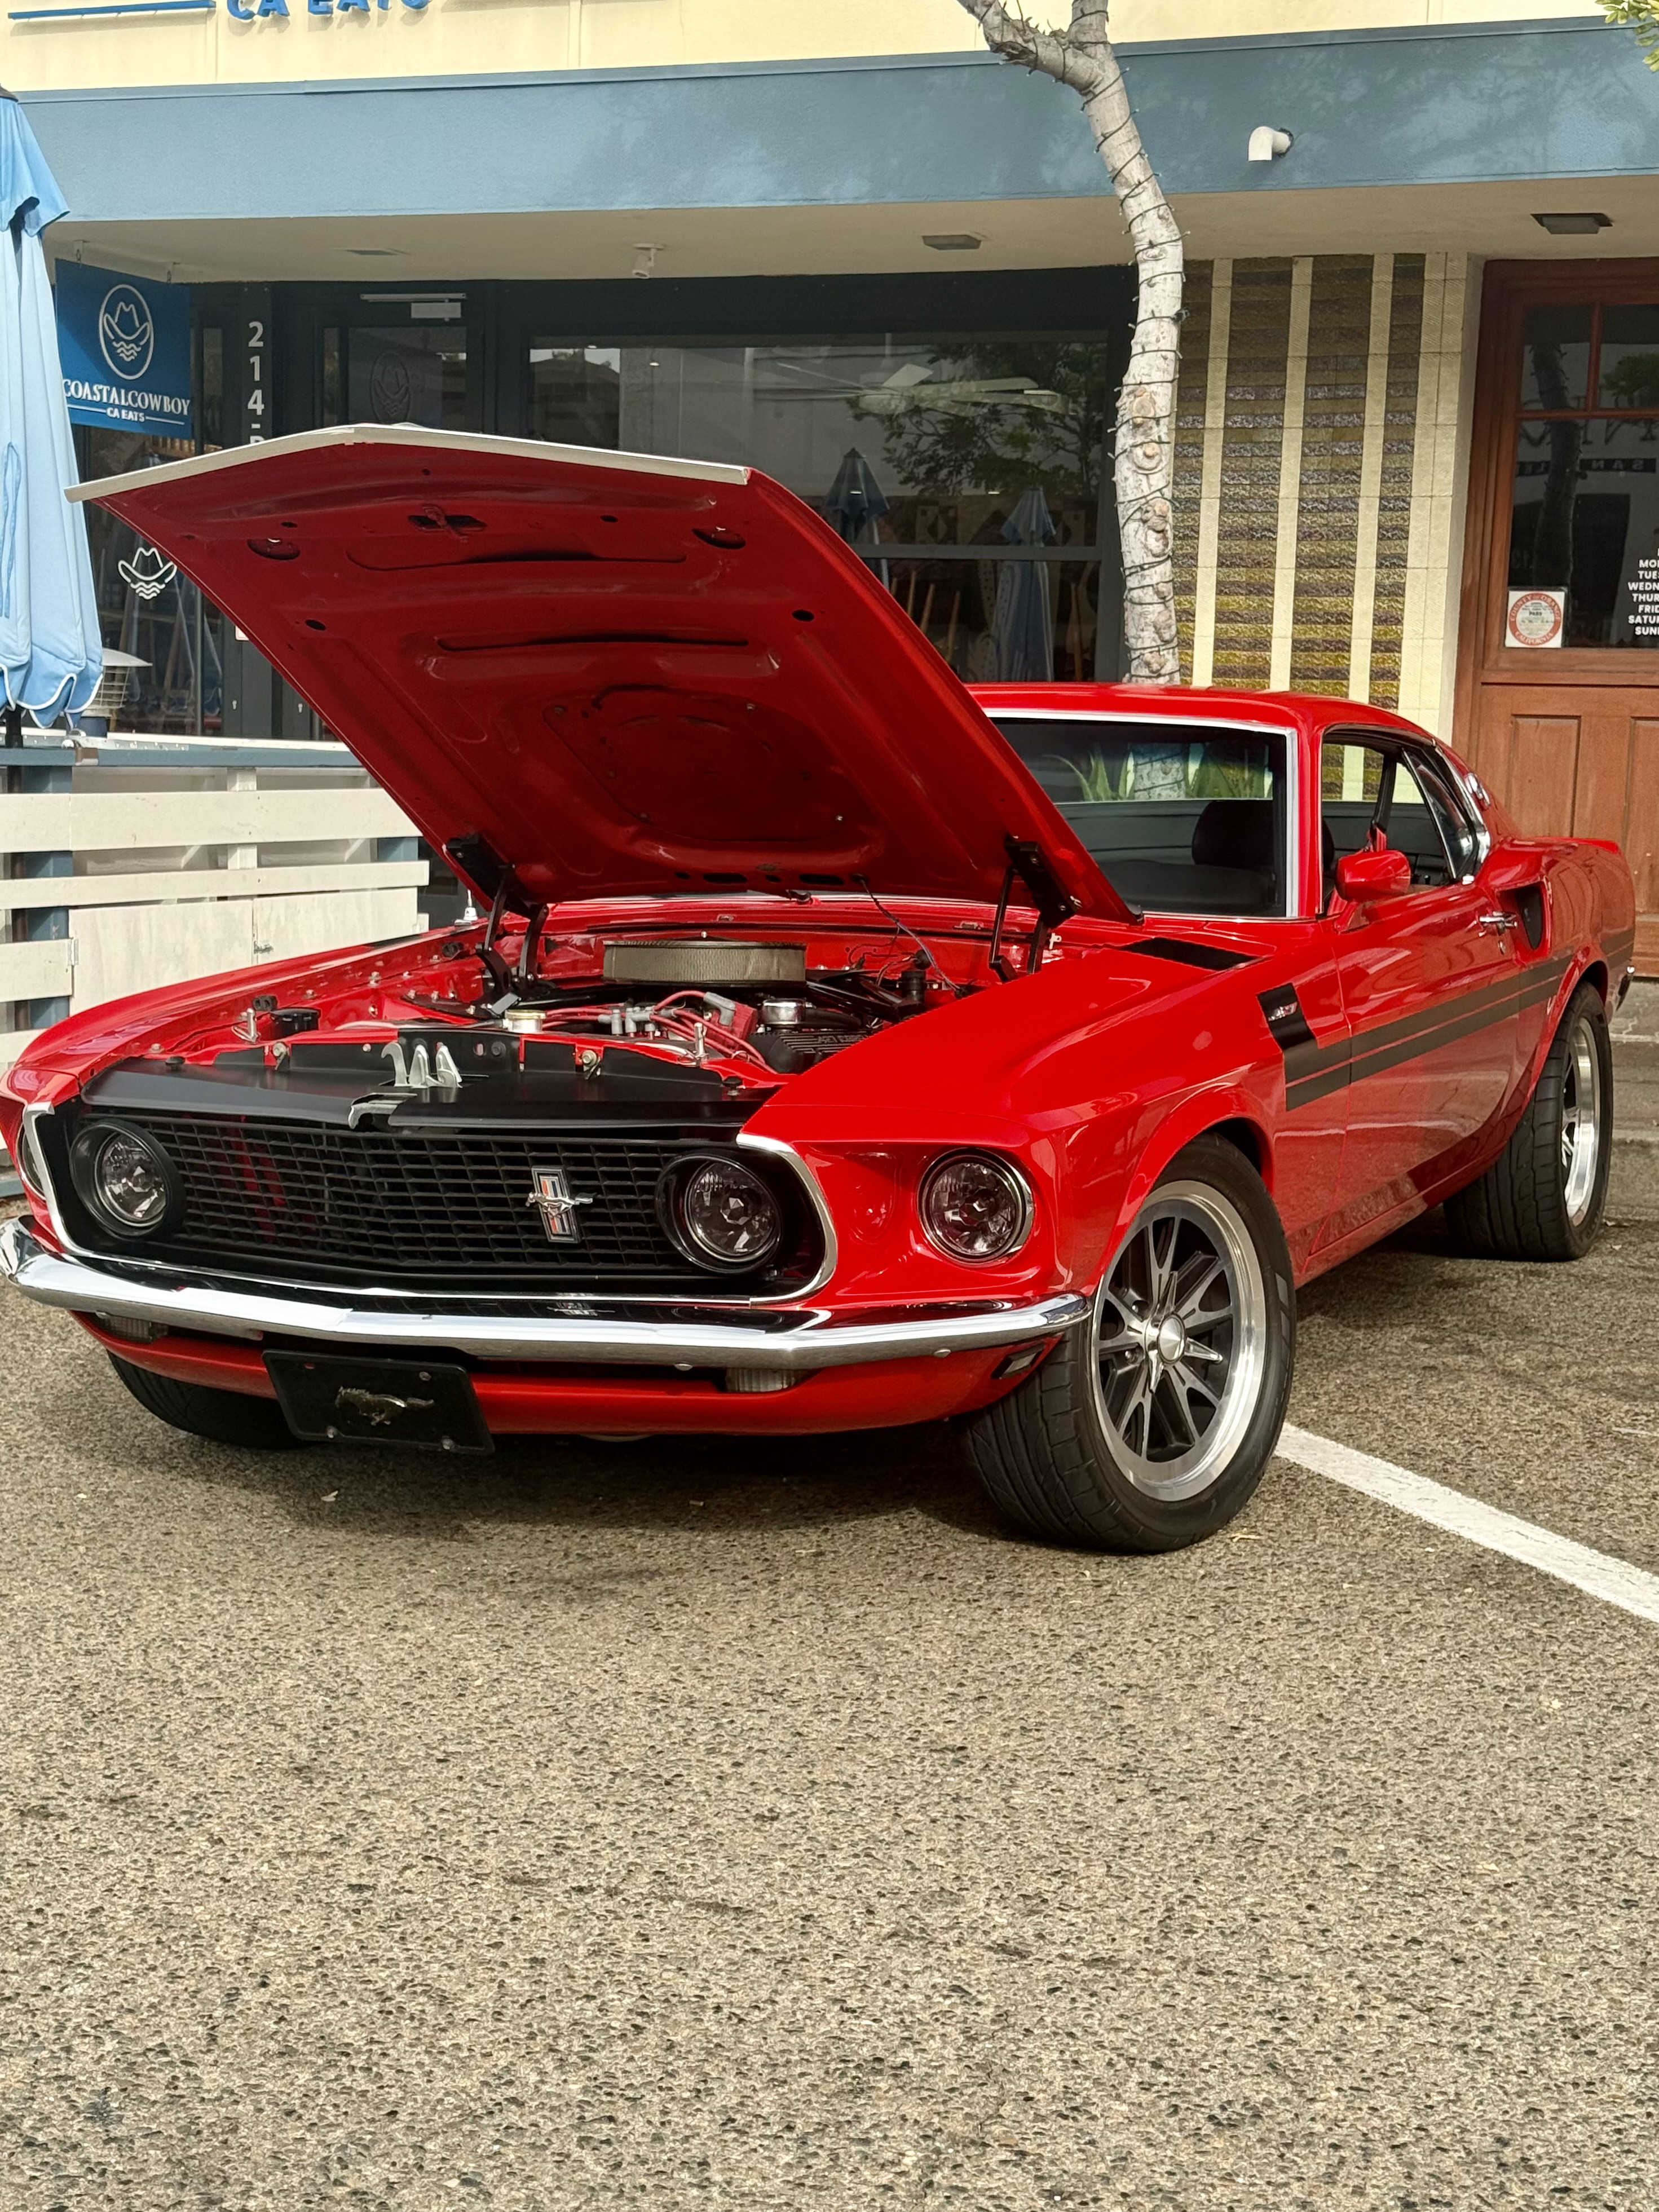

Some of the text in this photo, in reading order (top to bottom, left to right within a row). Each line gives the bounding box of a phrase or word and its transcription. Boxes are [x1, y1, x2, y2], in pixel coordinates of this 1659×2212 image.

[106, 407, 145, 422] CA EATS
[1639, 559, 1659, 568] MO
[1638, 571, 1659, 580] TUE
[1627, 582, 1659, 591] WEDN
[1635, 626, 1659, 635] SUN
